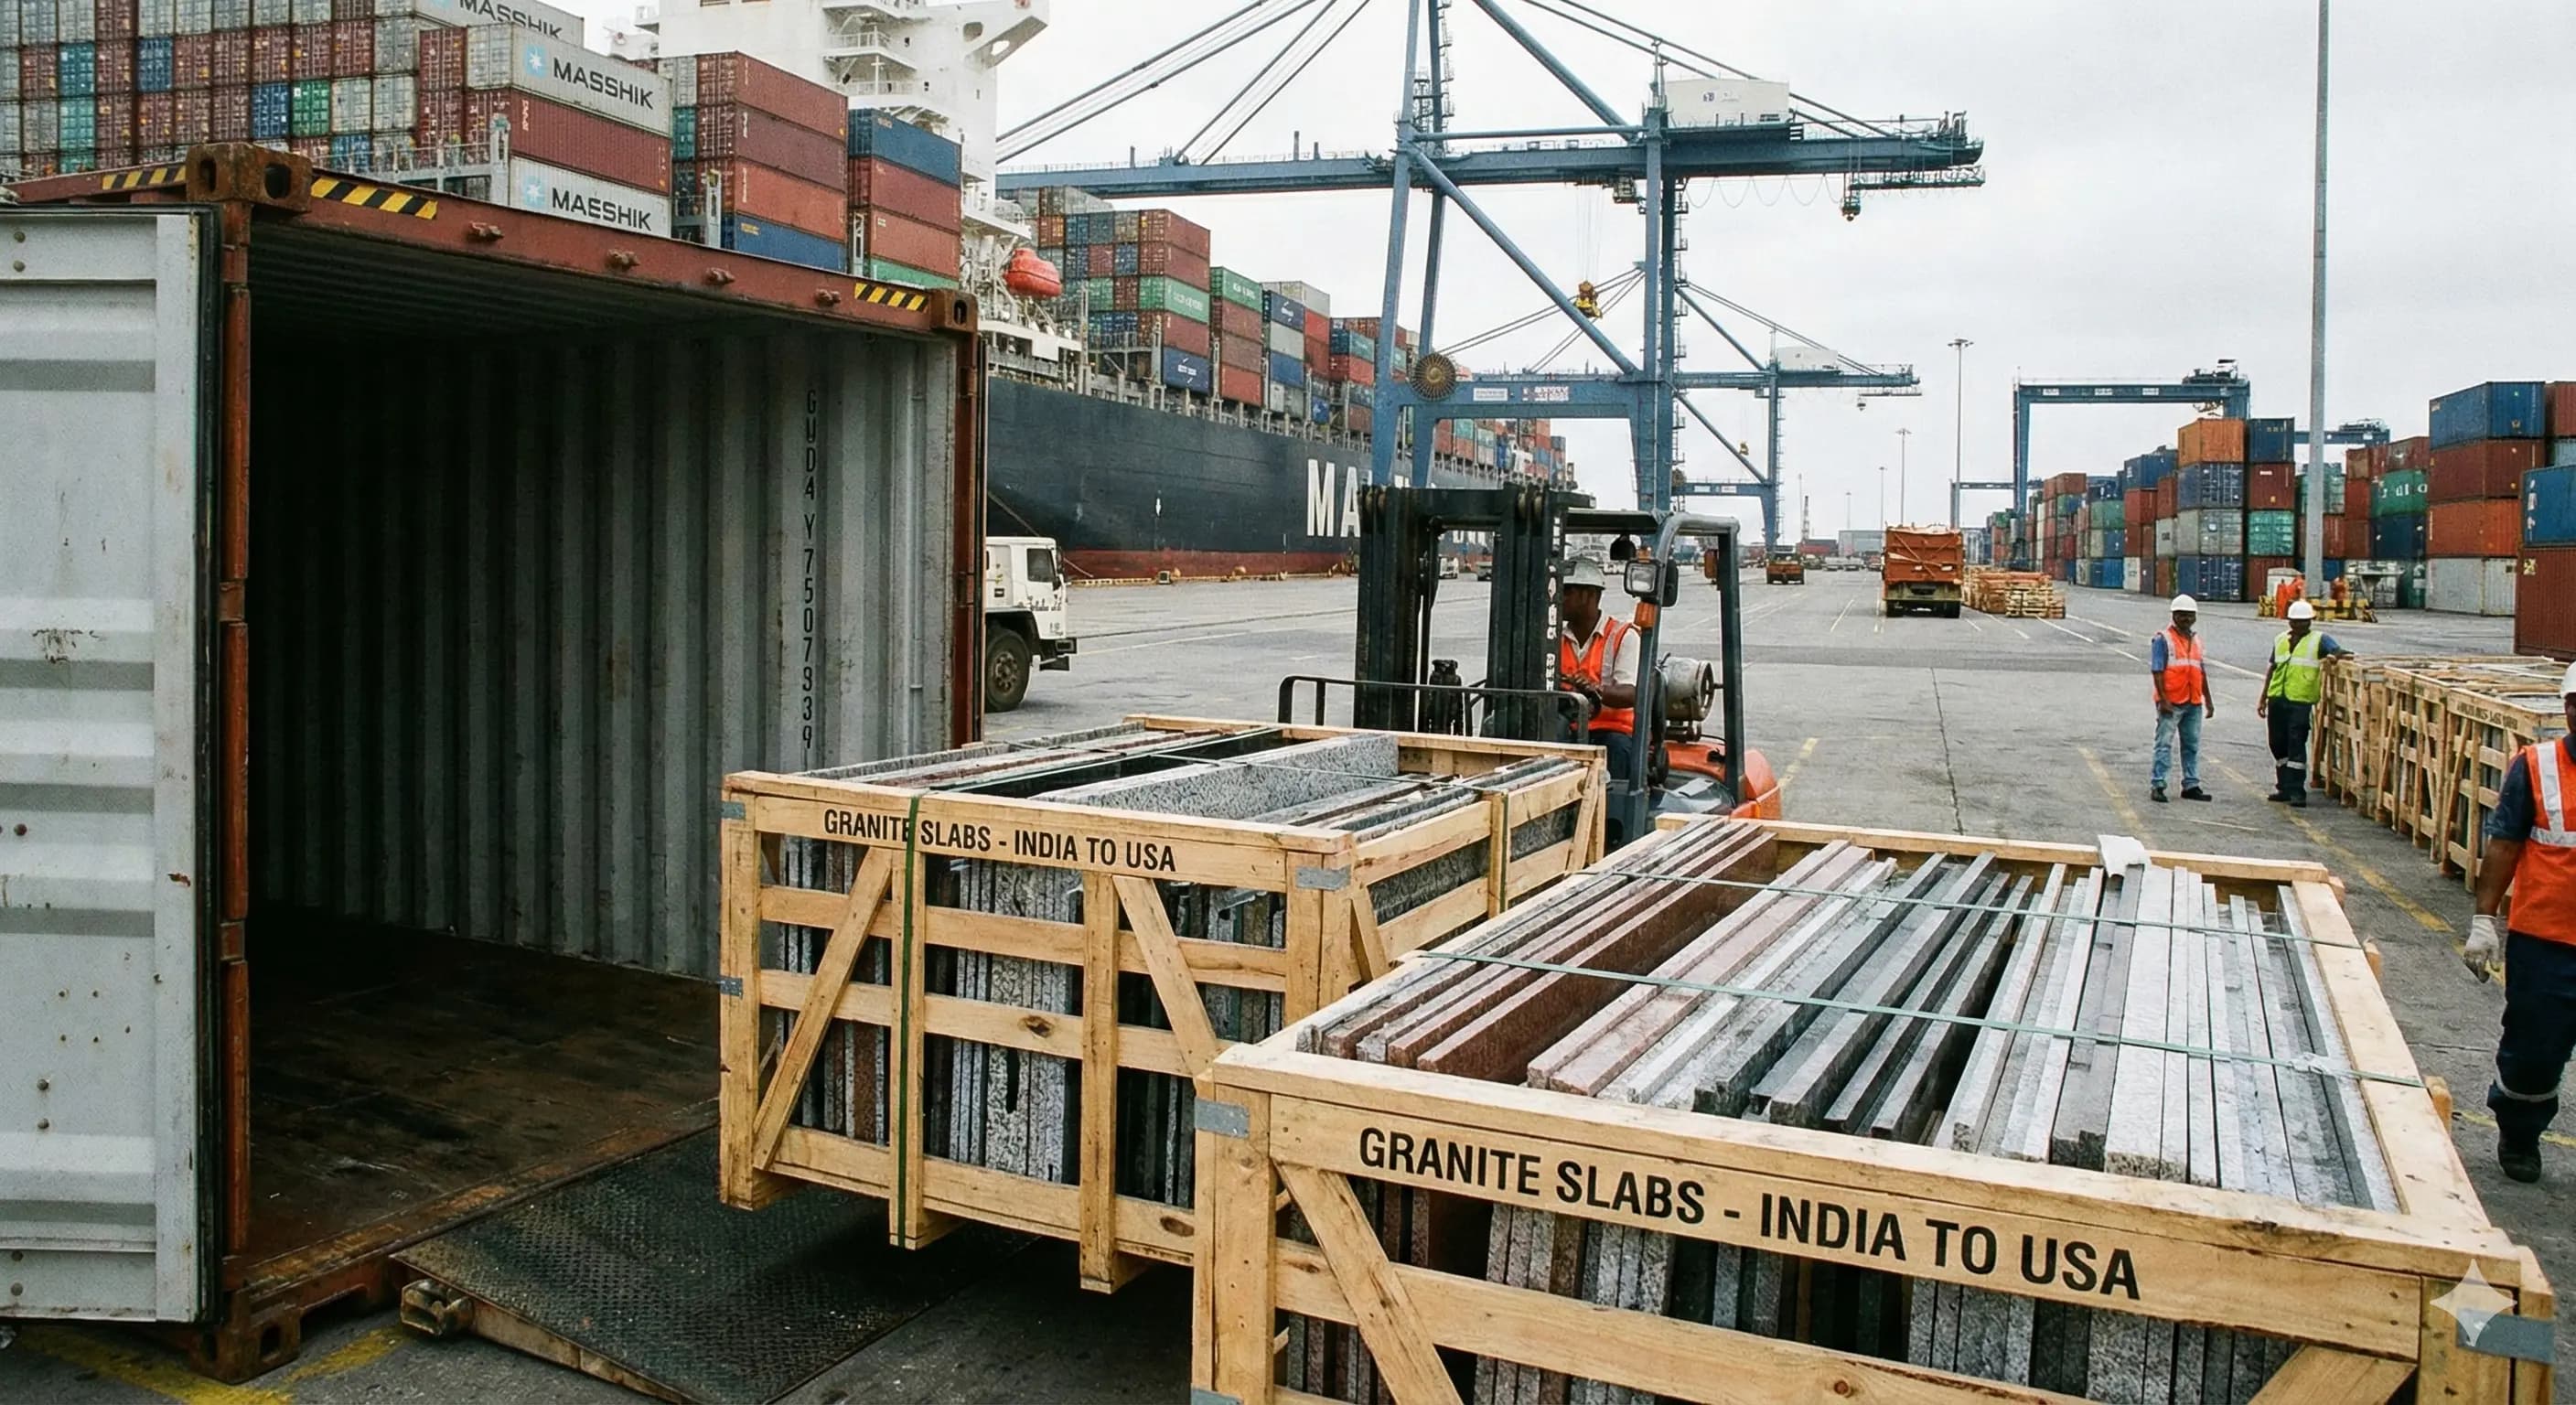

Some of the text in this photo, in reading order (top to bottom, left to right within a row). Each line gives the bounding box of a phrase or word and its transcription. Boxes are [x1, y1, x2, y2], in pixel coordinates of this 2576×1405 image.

[553, 58, 653, 110] MASSHIK
[824, 808, 910, 842] GRANITE
[920, 820, 992, 852] SLABS
[1014, 830, 1078, 862] INDIA
[1086, 837, 1117, 865] TO
[1126, 842, 1177, 873] USA
[1359, 1127, 1541, 1196] GRANITE
[1556, 1160, 1705, 1225] SLABS
[1760, 1192, 1907, 1261] INDIA
[1926, 1218, 1998, 1276] TO
[2021, 1234, 2141, 1301] USA
